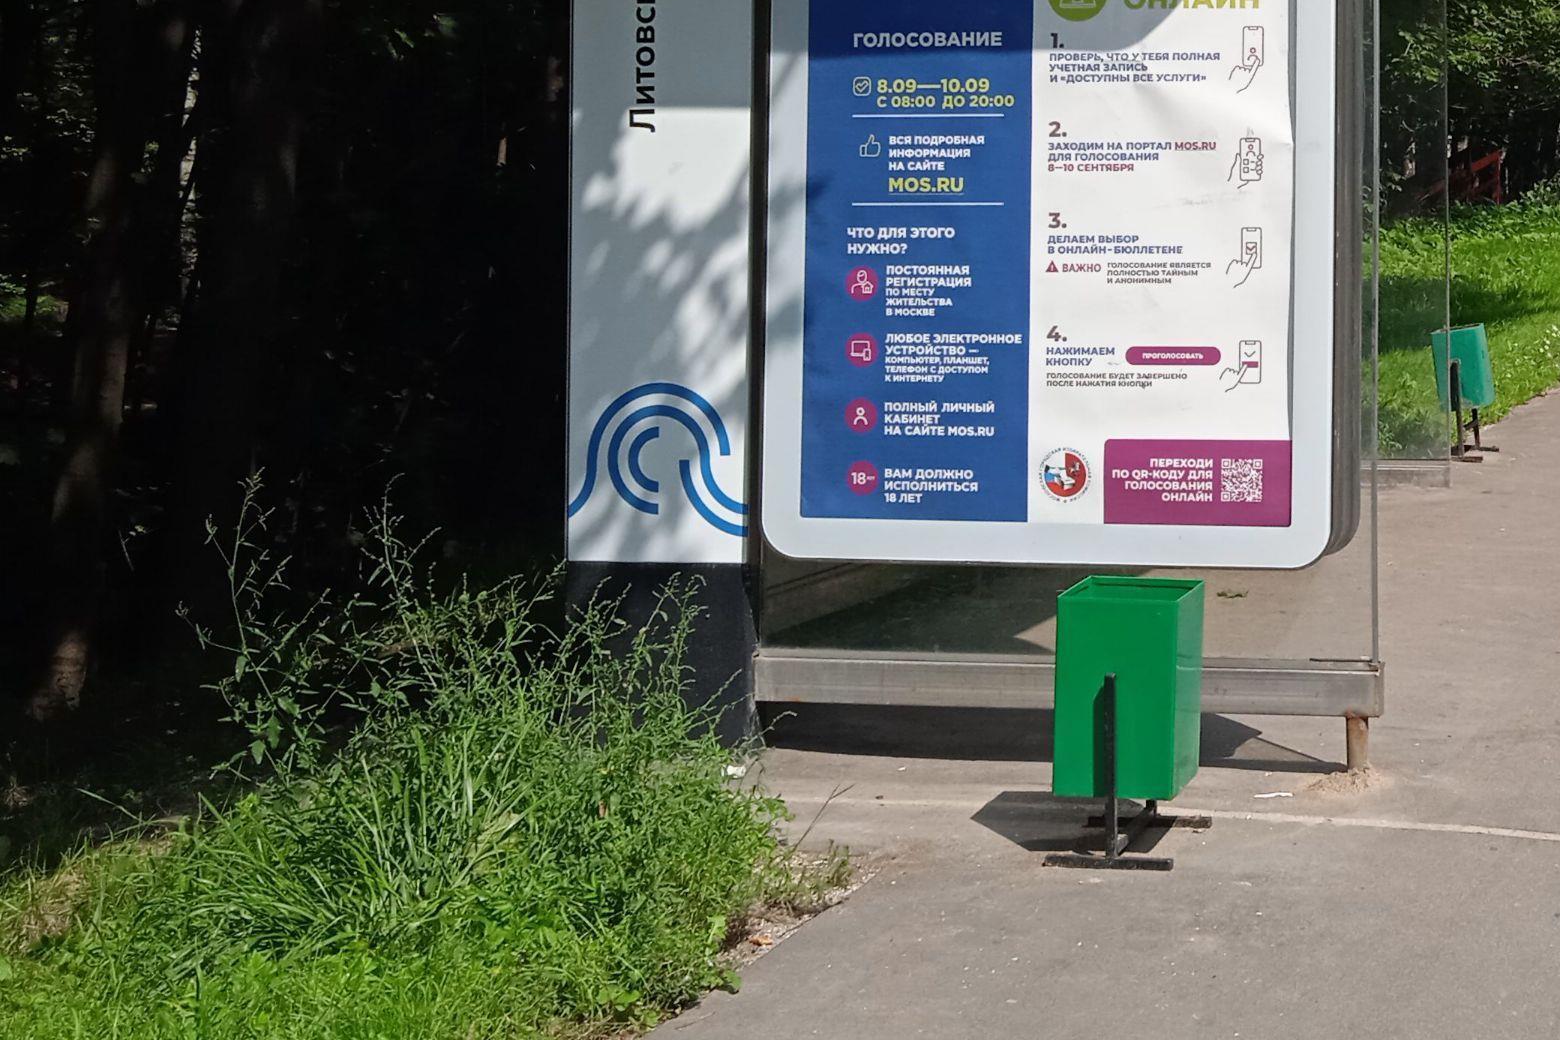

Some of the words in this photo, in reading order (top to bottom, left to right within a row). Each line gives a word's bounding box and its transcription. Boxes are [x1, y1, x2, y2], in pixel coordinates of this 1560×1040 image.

[853, 32, 1002, 48] ГОЛОСОВАНИЕ
[1050, 52, 1104, 63] ПРОВЕРЬ,
[1107, 52, 1129, 61] ЧТО
[1132, 52, 1140, 61] У
[1142, 52, 1169, 61] ТЕБЯ
[1172, 52, 1220, 61] ПОЛНАЯ
[1049, 64, 1100, 72] УЧЕТНАЯ
[1103, 63, 1148, 72] ЗАПИСЬ
[1050, 74, 1058, 83] И
[1060, 73, 1130, 84] «ДОСТУПНЫ
[1133, 74, 1153, 82] ВСЕ
[1157, 73, 1206, 82] УСЛУГИ»
[877, 97, 887, 108] С
[891, 96, 935, 108] 08:00
[942, 95, 965, 109] ДО
[969, 95, 1015, 107] 20:00
[1049, 121, 1067, 137] 2.
[889, 136, 912, 145] ВСЯ
[914, 135, 984, 146] ПОДРОБНАЯ
[1048, 142, 1104, 152] ЗАХОДИМ
[1107, 142, 1123, 150] НА
[1126, 142, 1172, 150] ПОРТАЛ
[1175, 141, 1216, 151] MOS.RU
[889, 149, 970, 159] ИНФОРМАЦИЯ
[1048, 153, 1072, 162] ДЛЯ
[1075, 153, 1159, 161] ГОЛОСОВАНИЯ
[889, 162, 905, 171] НА
[907, 160, 944, 171] САЙТЕ
[1077, 163, 1134, 172] СЕНТЯБРЯ
[889, 178, 964, 192] MOS.RU
[1048, 213, 1067, 229] 3.
[847, 228, 874, 238] ЧТО
[878, 227, 907, 239] ДЛЯ
[910, 227, 955, 238] ЭТОГО
[1048, 235, 1095, 245] ДЕЛАЕМ
[1098, 235, 1139, 244] ВЫБОР
[847, 243, 907, 255] НУЖНО?
[1048, 246, 1055, 254] В
[886, 266, 970, 275] ПОСТОЯННАЯ
[1062, 264, 1101, 273] ВАЖНО
[886, 277, 971, 288] РЕГИСТРАЦИЯ
[902, 288, 935, 296] МЕСТУ
[886, 298, 952, 307] ЖИТЕЛЬСТВА
[886, 308, 892, 316] В
[894, 308, 935, 316] МОСКВЕ
[1047, 325, 1067, 342] 4.
[885, 334, 931, 344] ЛЮБОЕ
[933, 334, 1022, 344] ЭЛЕКТРОННОЕ
[885, 345, 966, 355] УСТРОЙСТВО
[1046, 347, 1115, 355] НАЖИМАЕМ
[885, 356, 942, 365] КОМПЬЮТЕР,
[944, 356, 990, 365] ПЛАНШЕТ,
[1046, 358, 1092, 366] КНОПКУ
[1142, 352, 1203, 360] ПРОГОЛОСОВАТЬ
[885, 366, 929, 374] ТЕЛЕФОН
[930, 366, 936, 374] С
[938, 366, 988, 374] ДОСТУПОМ
[885, 374, 891, 382] К
[893, 374, 944, 382] ИНТЕРНЕТУ
[884, 401, 937, 413] ПОЛНЫЙ
[941, 401, 995, 413] ЛИЧНЫЙ
[884, 415, 940, 424] КАБИНЕТ
[884, 426, 902, 436] НА
[905, 424, 945, 436] САЙТЕ
[948, 426, 995, 436] MOS.RU
[1150, 459, 1213, 469] ПЕРЕХОДИ
[885, 469, 912, 479] ВАМ
[915, 469, 974, 481] ДОЛЖНО
[1112, 470, 1129, 479] ПО
[1132, 469, 1184, 480] QR-КОДУ
[1188, 470, 1213, 480] ДЛЯ
[885, 482, 978, 492] ИСПОЛНИТЬСЯ
[1125, 481, 1213, 491] ГОЛОСОВАНИЯ
[885, 493, 896, 503] 18
[899, 493, 922, 503] ЛЕТ
[1162, 491, 1213, 502] ОНЛАЙН
